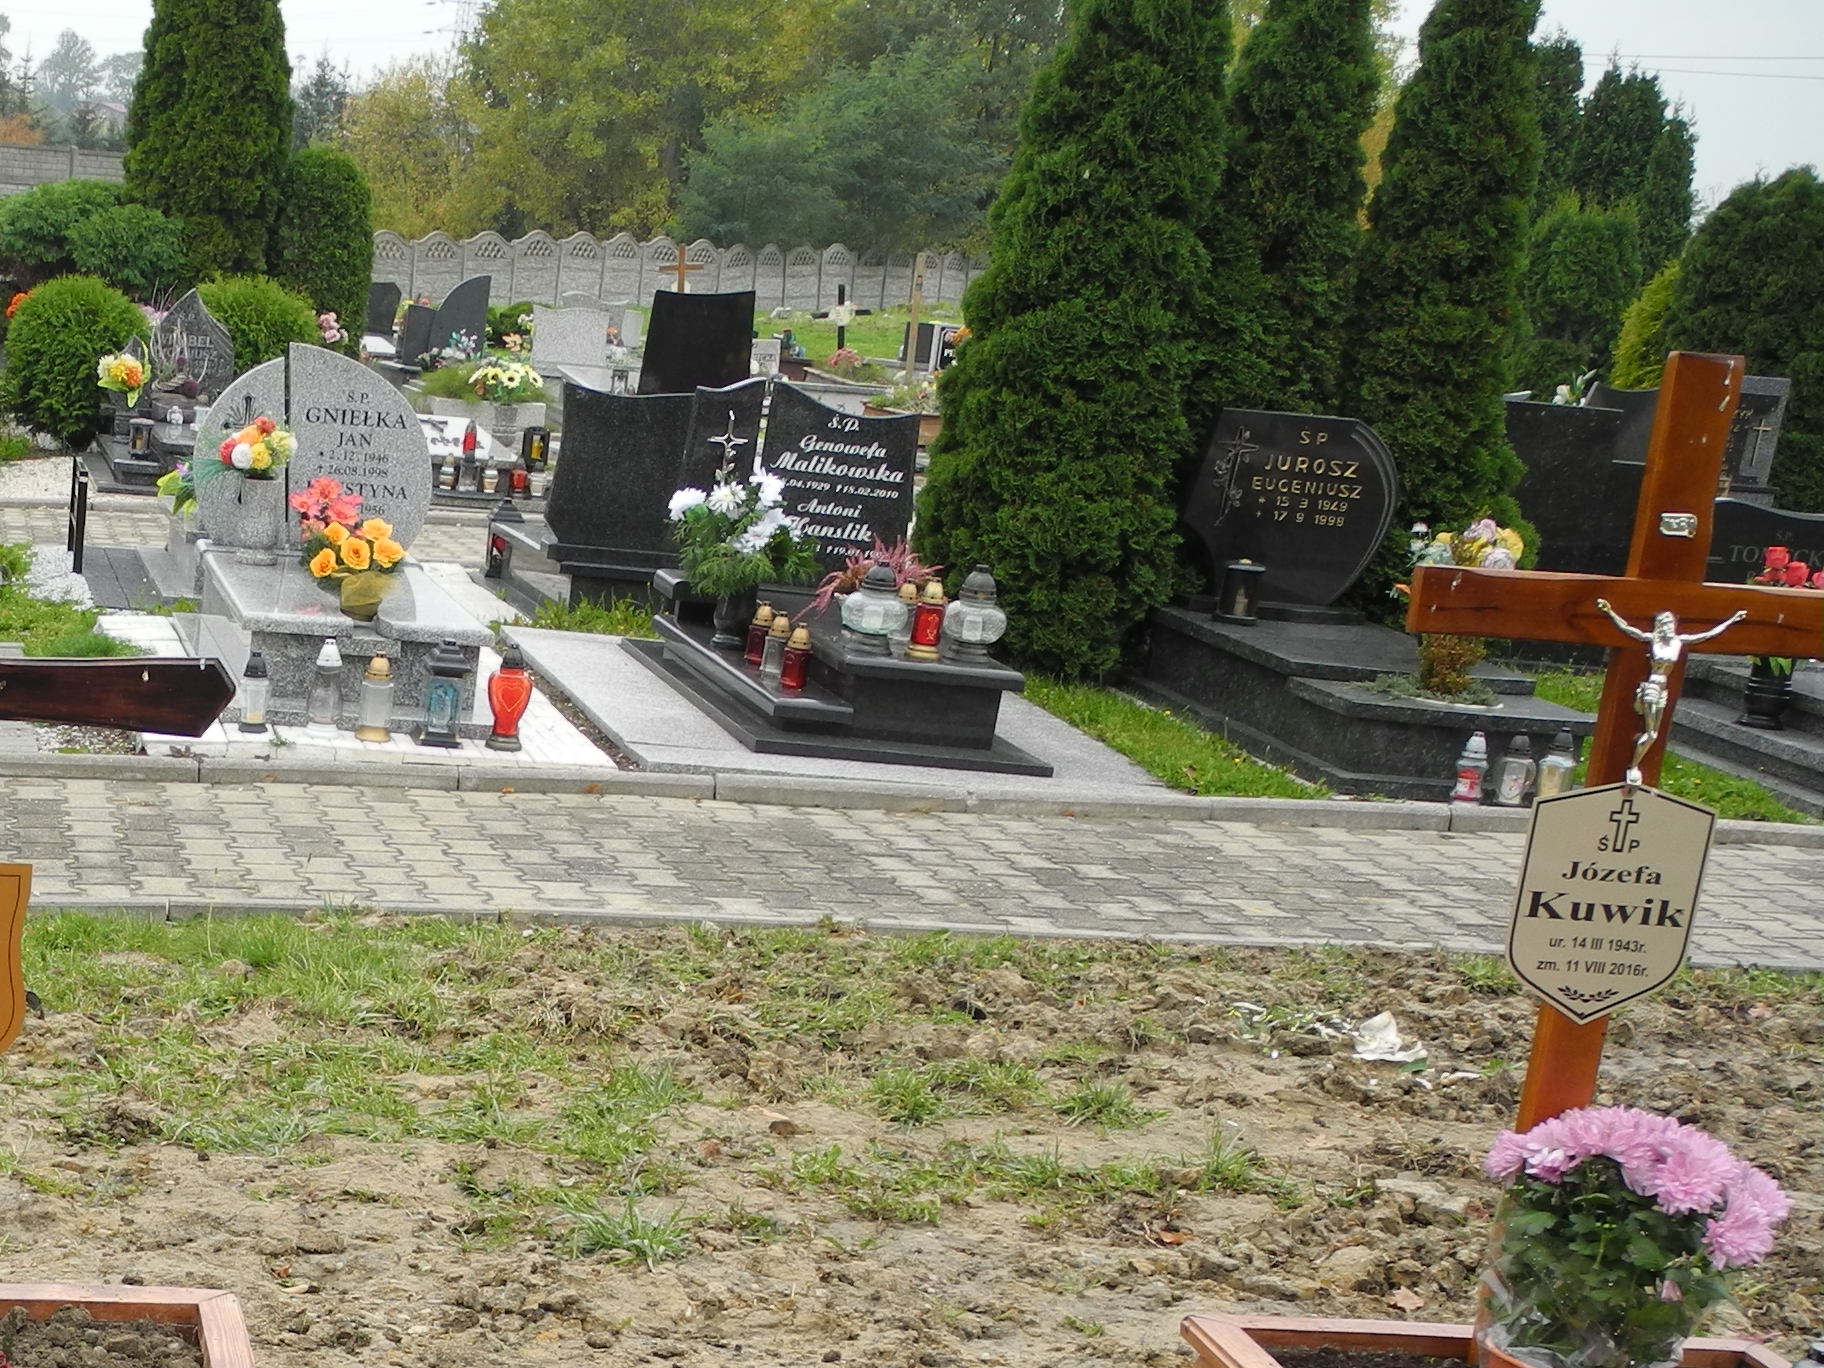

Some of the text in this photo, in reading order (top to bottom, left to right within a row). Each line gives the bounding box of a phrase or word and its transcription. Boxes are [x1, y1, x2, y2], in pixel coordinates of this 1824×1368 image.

[337, 431, 373, 448] JAN
[799, 433, 889, 460] Genowefa
[769, 450, 905, 484] Malikowska
[1264, 453, 1360, 478] JUROSZ
[1251, 475, 1363, 500] EUGENIUSZ
[797, 498, 863, 519] Antoni
[1276, 495, 1290, 507] 15
[1273, 510, 1288, 521] 17
[1597, 834, 1640, 853] Ś P
[1562, 861, 1662, 885] Józefa
[1524, 889, 1686, 928] Kuwik
[1548, 936, 1648, 954] ur. 14 III 1943r.
[1536, 960, 1649, 978] zm. 11 VIII 2016r.
